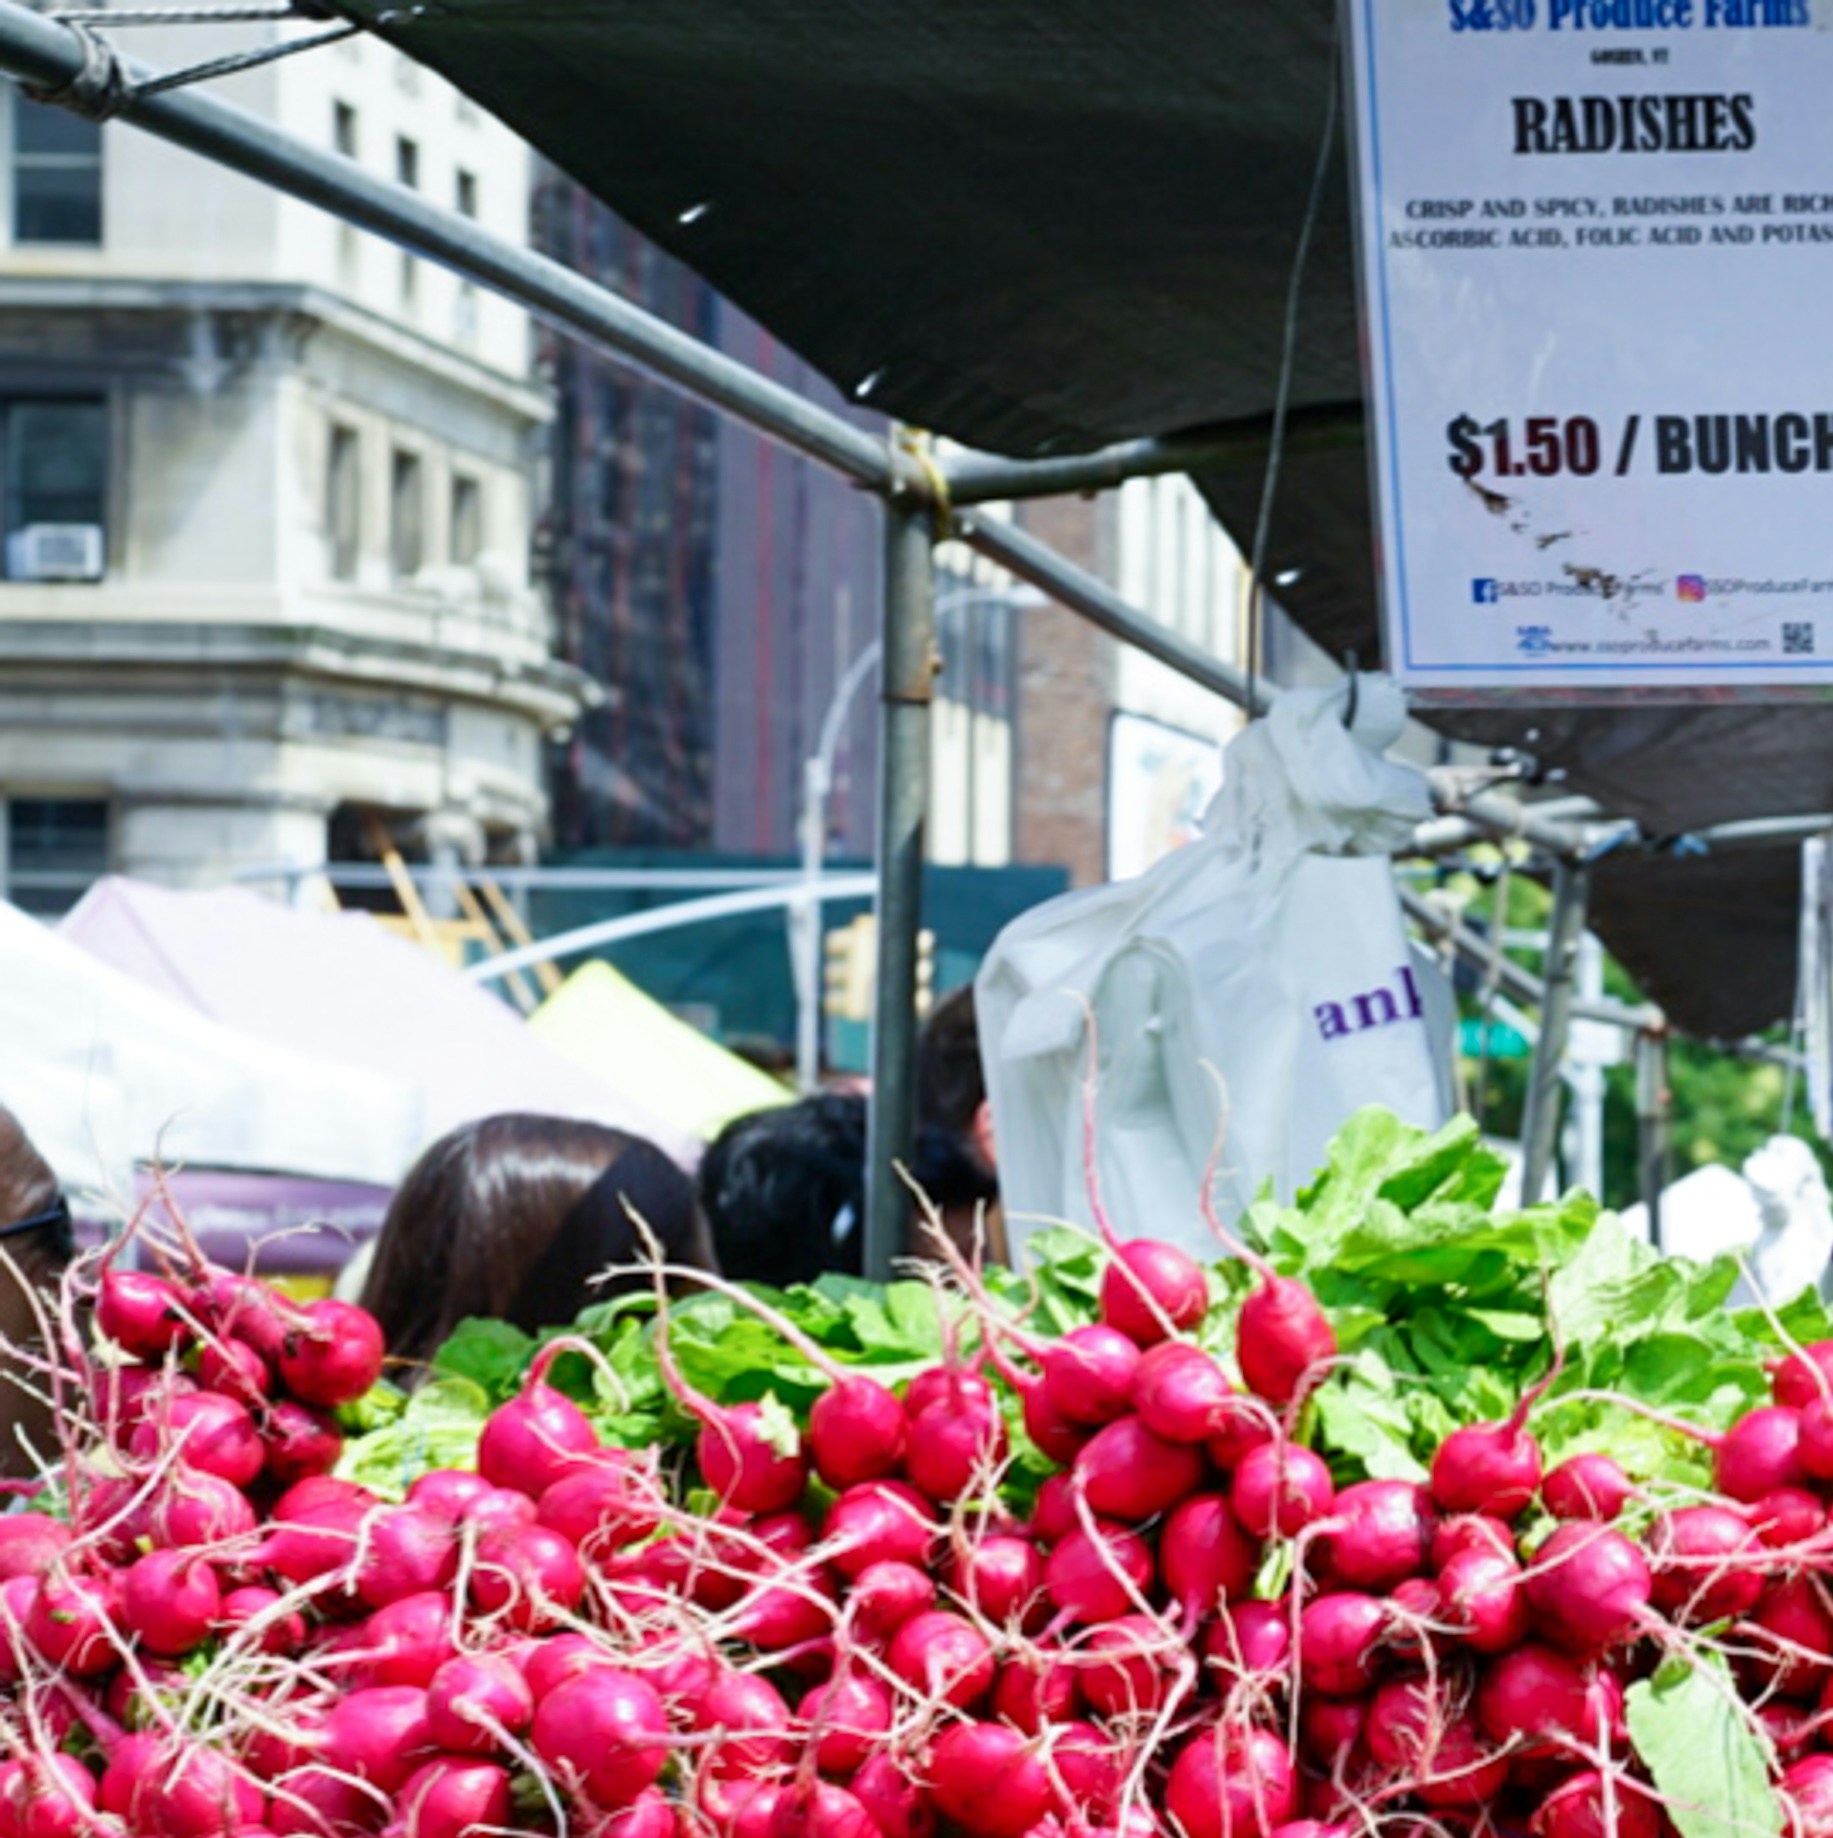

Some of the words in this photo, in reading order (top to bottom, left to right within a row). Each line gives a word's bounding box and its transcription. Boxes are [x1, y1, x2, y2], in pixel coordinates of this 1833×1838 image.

[1548, 0, 1692, 30] Produce
[1511, 94, 1756, 154] RADISHES
[1405, 198, 1474, 219] CRISP
[1480, 198, 1527, 218] AND
[1533, 197, 1607, 218] SPICY,
[1613, 195, 1726, 217] RADISHES
[1732, 194, 1776, 215] ARE
[1390, 228, 1500, 249] ASCORBIC
[1508, 227, 1569, 248] ACID,
[1575, 226, 1643, 247] FOLIC
[1648, 225, 1702, 245] ACID
[1708, 223, 1755, 244] AND
[1446, 412, 1600, 479] $1.50
[1614, 414, 1641, 477] /
